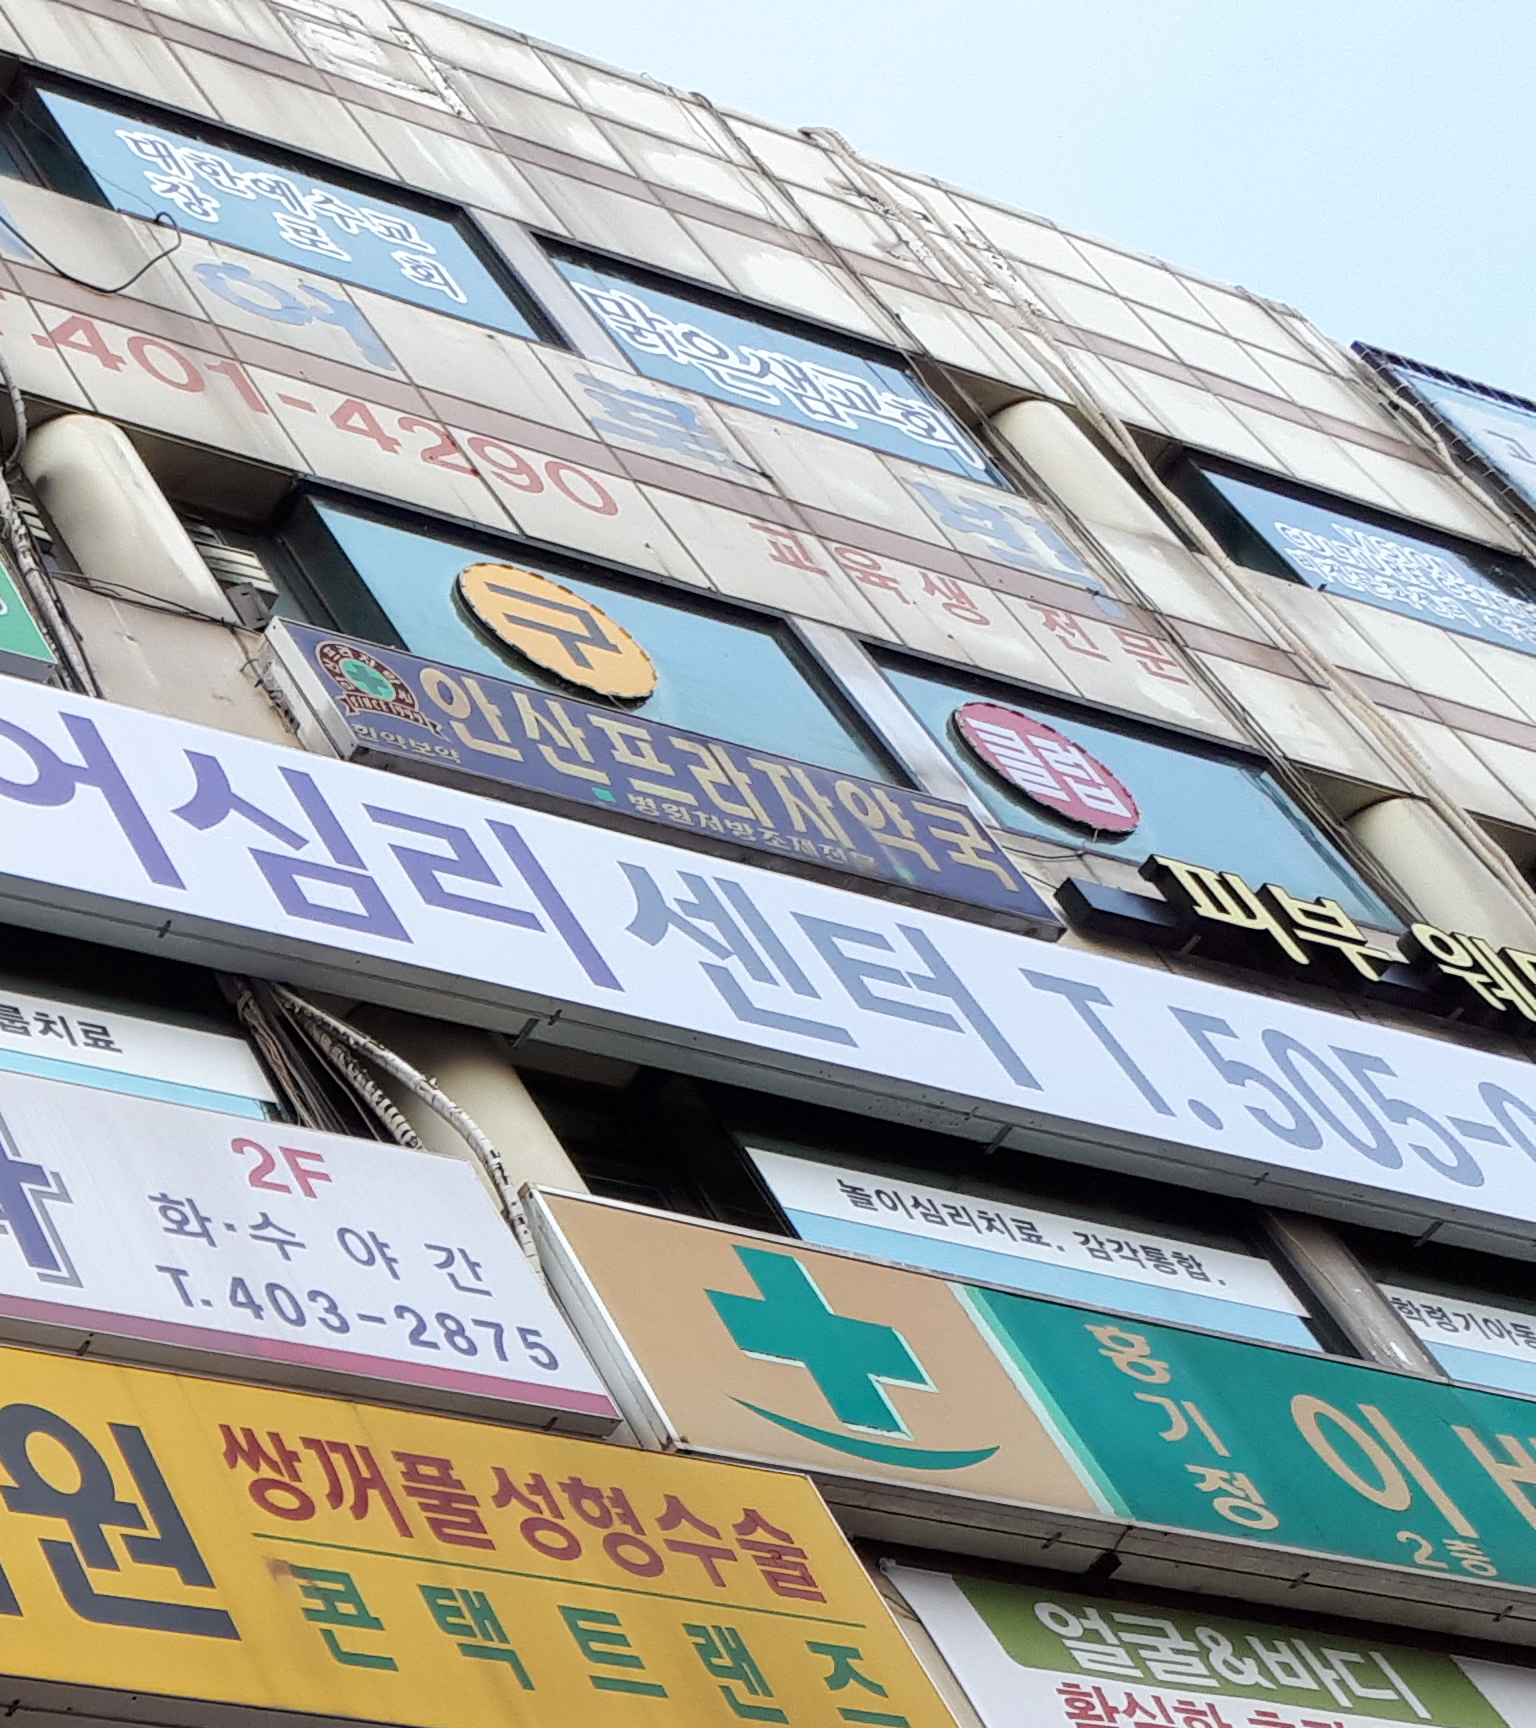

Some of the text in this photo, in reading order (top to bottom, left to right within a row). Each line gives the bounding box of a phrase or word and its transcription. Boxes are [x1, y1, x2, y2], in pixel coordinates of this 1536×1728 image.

[115, 130, 436, 255] 대한예수교
[571, 281, 986, 470] 맑은샘교회
[484, 580, 624, 671] 구
[419, 666, 1021, 893] 안산프라자약국
[1152, 854, 1393, 982] 피부
[230, 1138, 332, 1200] 2F
[154, 1263, 563, 1371] T.403-2875
[1395, 1530, 1499, 1578] 2층
[1033, 1601, 1433, 1720] 얼굴&바디
